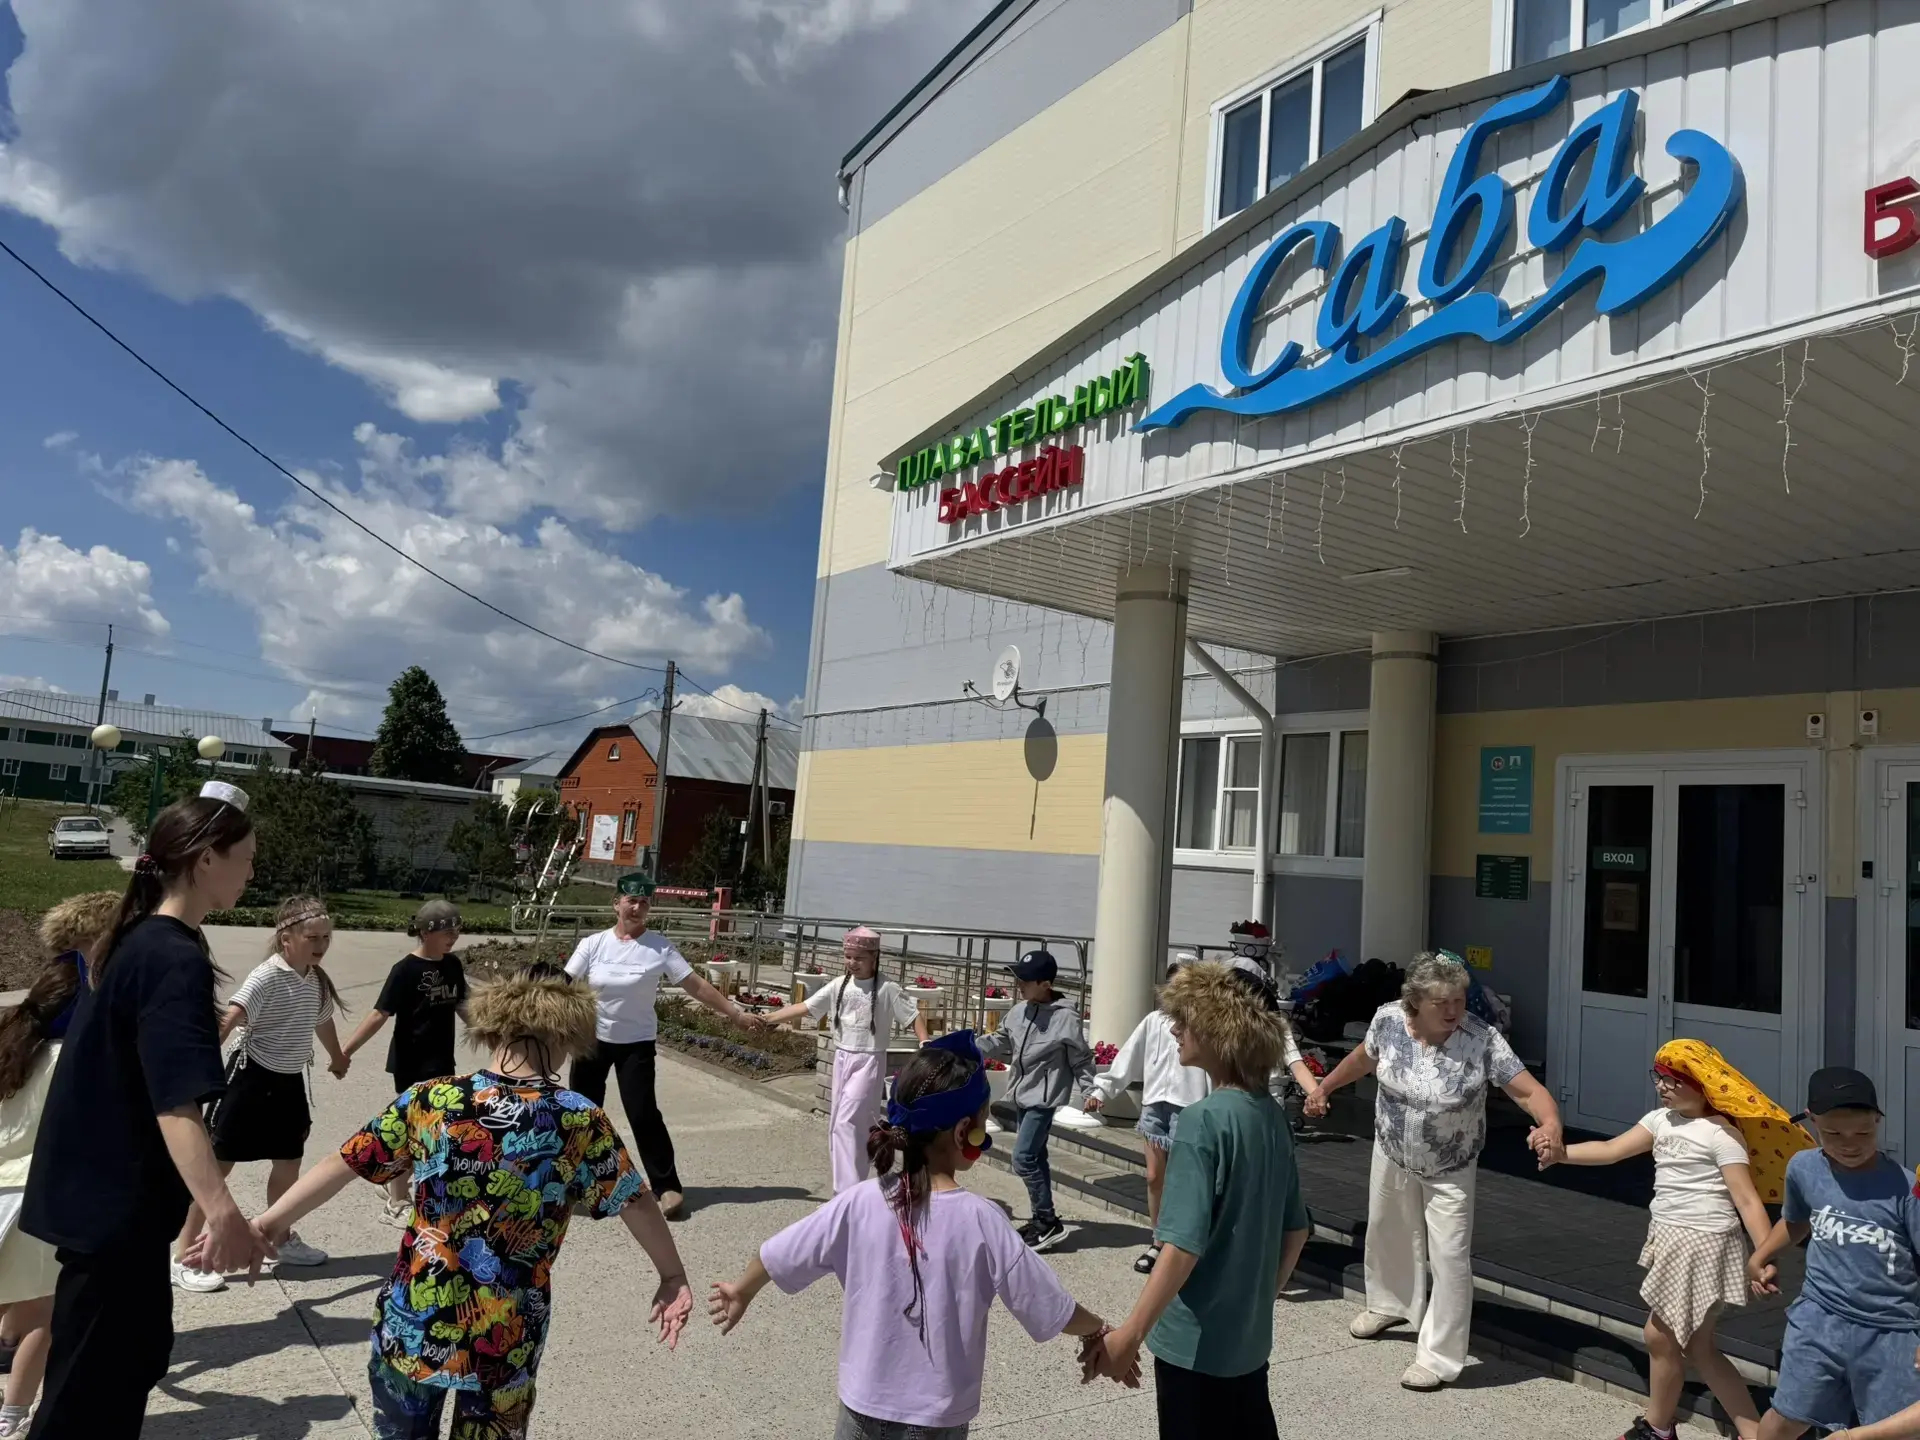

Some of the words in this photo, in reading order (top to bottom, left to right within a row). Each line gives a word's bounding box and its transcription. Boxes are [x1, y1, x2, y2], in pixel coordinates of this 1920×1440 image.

[1220, 74, 1649, 391] Саба
[897, 351, 1150, 492] ПЛАВАТЕЛЬНЫЙ
[937, 444, 1084, 525] БАССЕЙН
[1602, 852, 1635, 865] ВХОД
